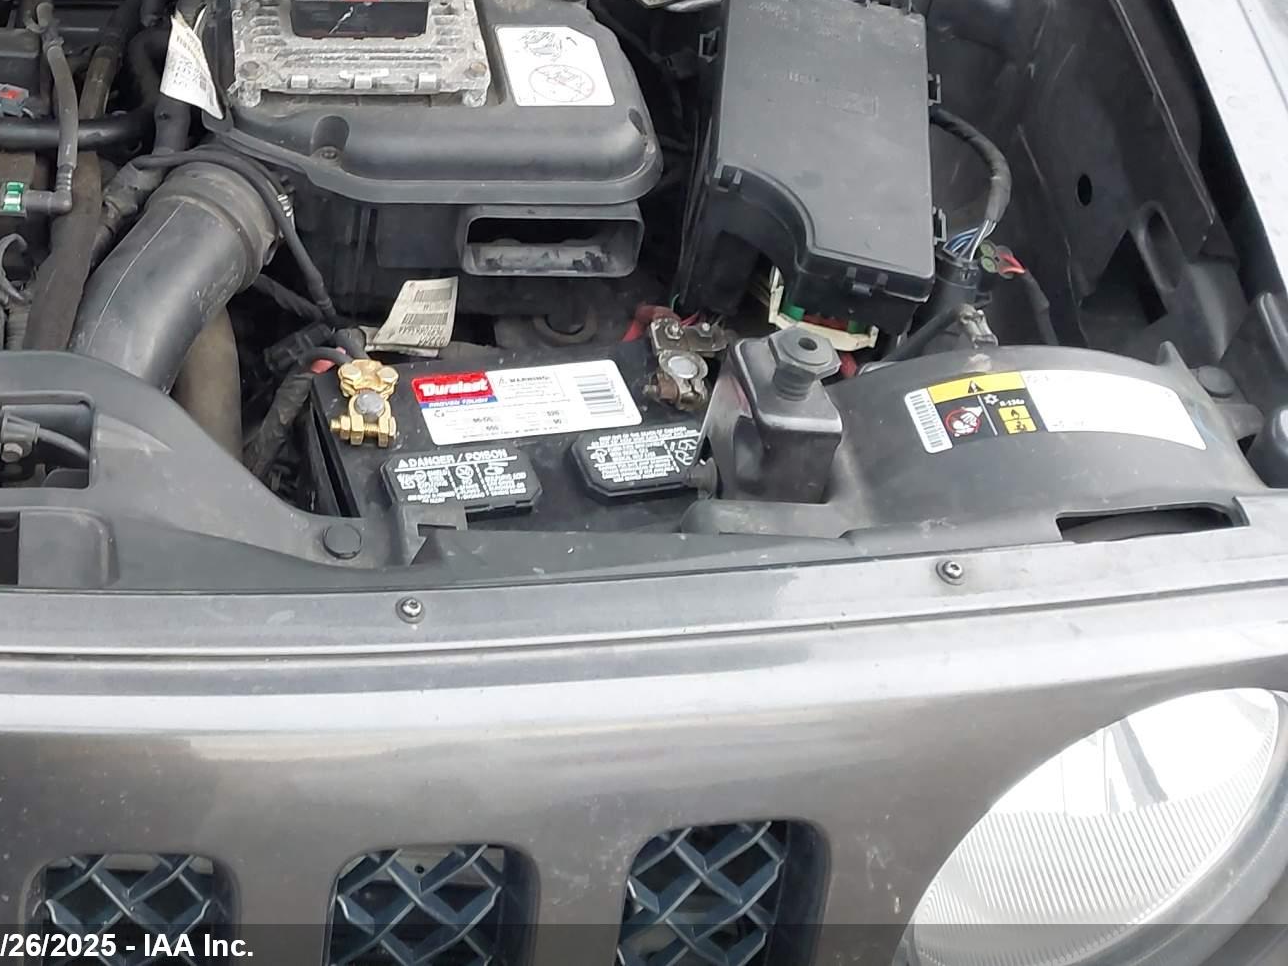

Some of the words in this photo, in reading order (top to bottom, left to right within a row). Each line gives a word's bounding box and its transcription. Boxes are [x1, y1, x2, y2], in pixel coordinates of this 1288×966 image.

[419, 378, 489, 396] Duralast
[408, 454, 455, 468] DANGER
[464, 448, 508, 461] POISON
